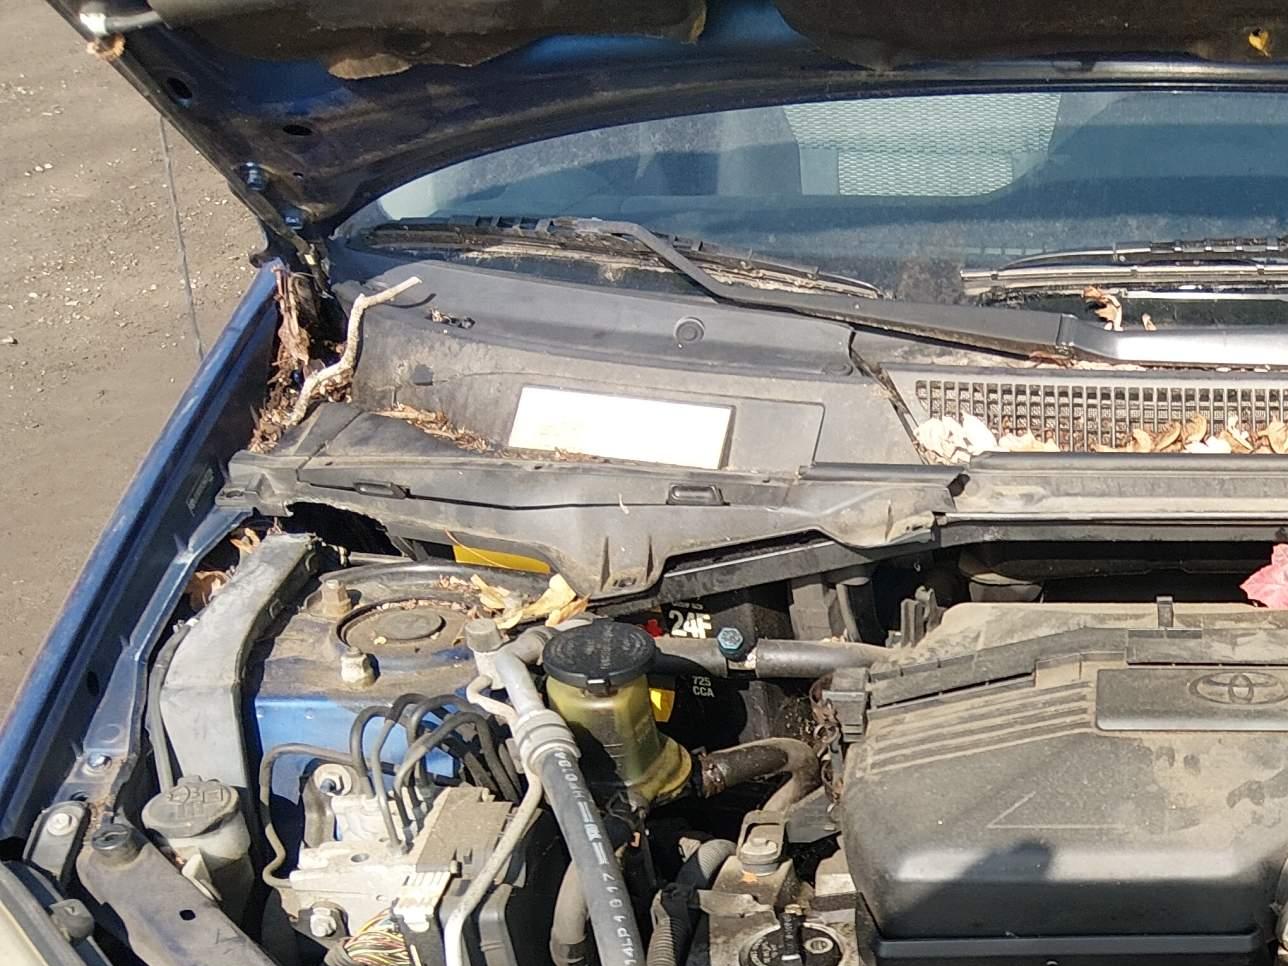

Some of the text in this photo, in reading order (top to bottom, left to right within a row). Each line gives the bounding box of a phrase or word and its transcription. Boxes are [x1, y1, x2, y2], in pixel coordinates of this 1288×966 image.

[668, 610, 712, 638] 24F
[691, 676, 711, 686] 725
[692, 686, 715, 698] CCA
